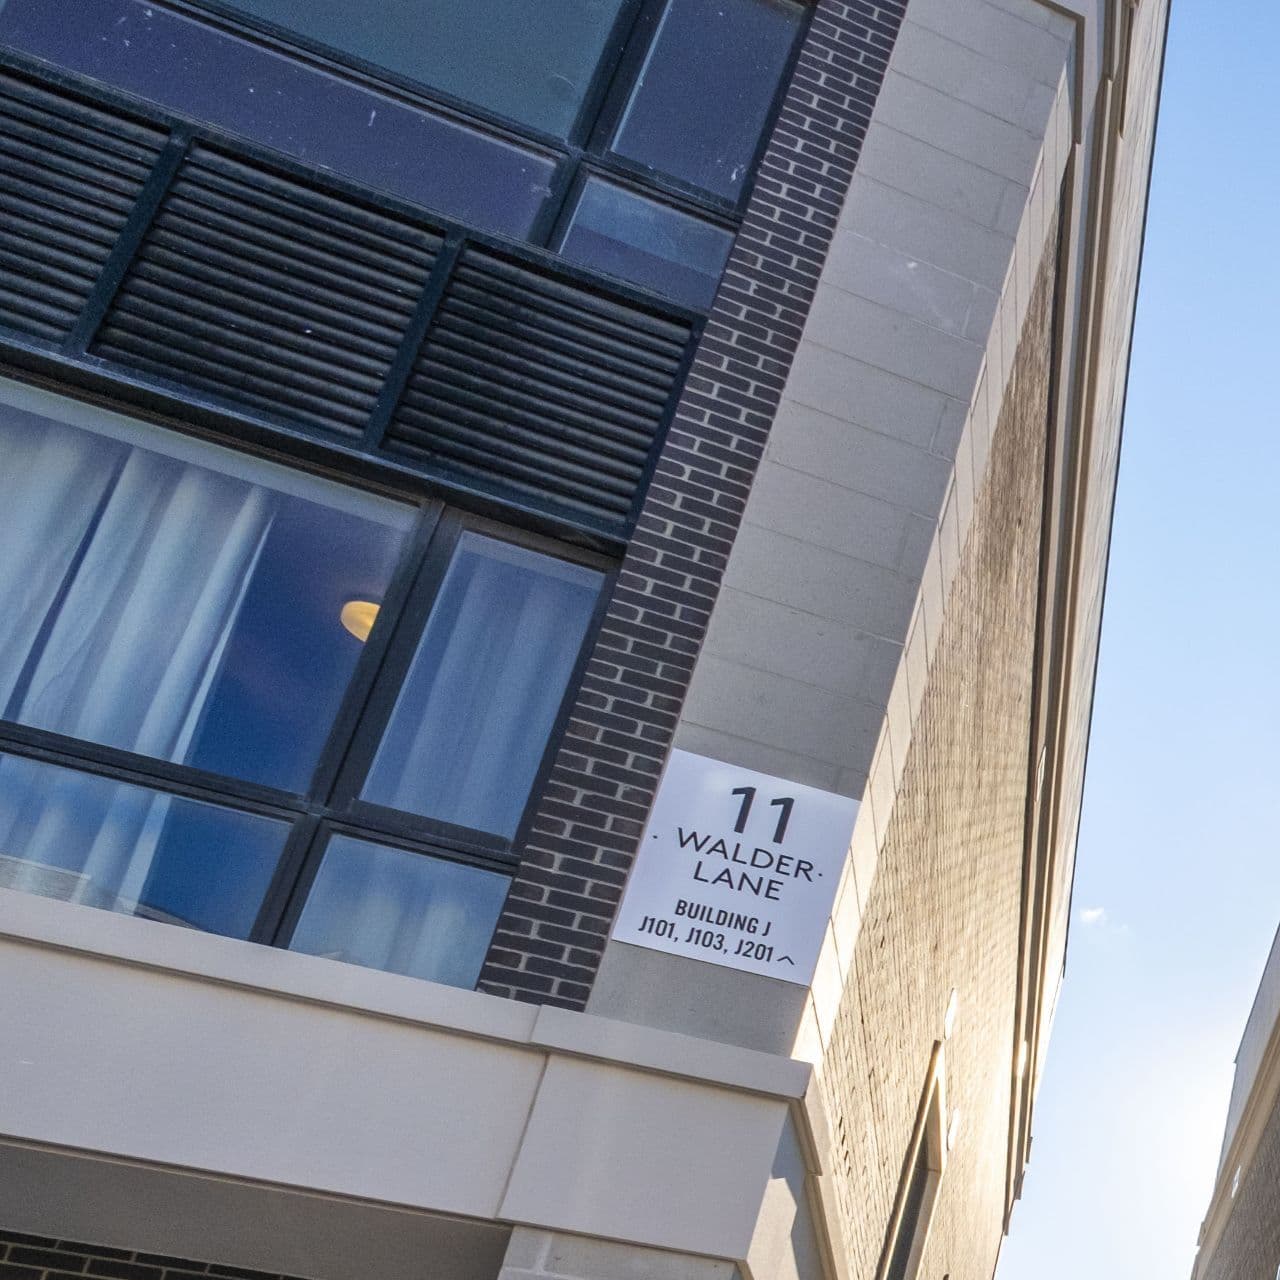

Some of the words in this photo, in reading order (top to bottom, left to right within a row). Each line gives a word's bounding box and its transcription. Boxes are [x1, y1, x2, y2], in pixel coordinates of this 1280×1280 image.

[732, 786, 795, 844] 11
[678, 827, 814, 882] WALDER
[693, 860, 784, 901] LANE
[638, 916, 679, 942] J101,
[685, 928, 728, 954] J103,
[734, 939, 774, 963] J201
[675, 899, 759, 934] BUILDING
[762, 922, 772, 937] J
